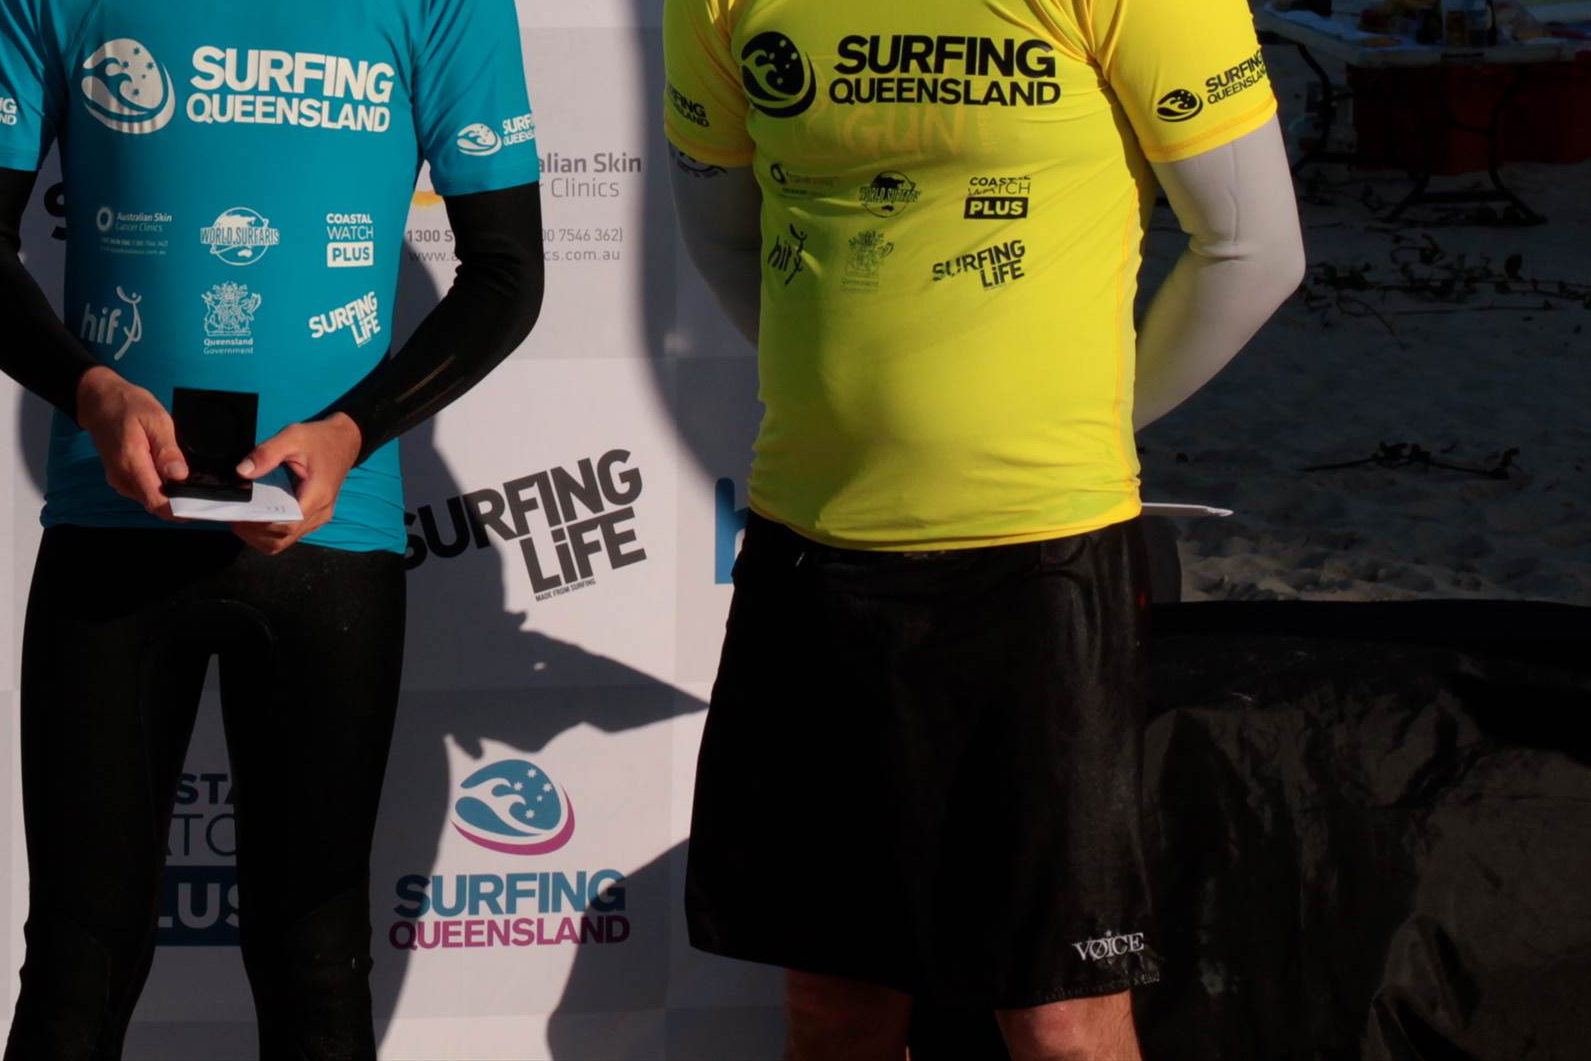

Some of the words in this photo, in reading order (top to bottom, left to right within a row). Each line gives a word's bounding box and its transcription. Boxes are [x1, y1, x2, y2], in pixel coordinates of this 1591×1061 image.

[833, 35, 1057, 78] SURFING
[190, 45, 395, 103] SURFING
[829, 77, 1062, 107] QUEENSLAND
[186, 93, 391, 133] QUEENSLAND
[593, 153, 642, 173] Skin
[552, 178, 620, 198] Clinics
[154, 213, 172, 222] Skin
[969, 201, 1023, 215] PLUS
[326, 213, 372, 224] COASTAL
[201, 227, 233, 244] WORLD
[235, 227, 280, 246] SURFARIS
[327, 226, 374, 240] WATCH
[407, 230, 442, 242] 1300
[559, 229, 591, 241] 7546
[332, 247, 370, 261] PLUS
[309, 292, 377, 338] SURFING
[204, 338, 253, 346] Queensland
[204, 347, 253, 355] Government
[405, 448, 643, 572] SURFING
[394, 869, 627, 919] SURFING
[389, 915, 630, 952] QUEENSLAND
